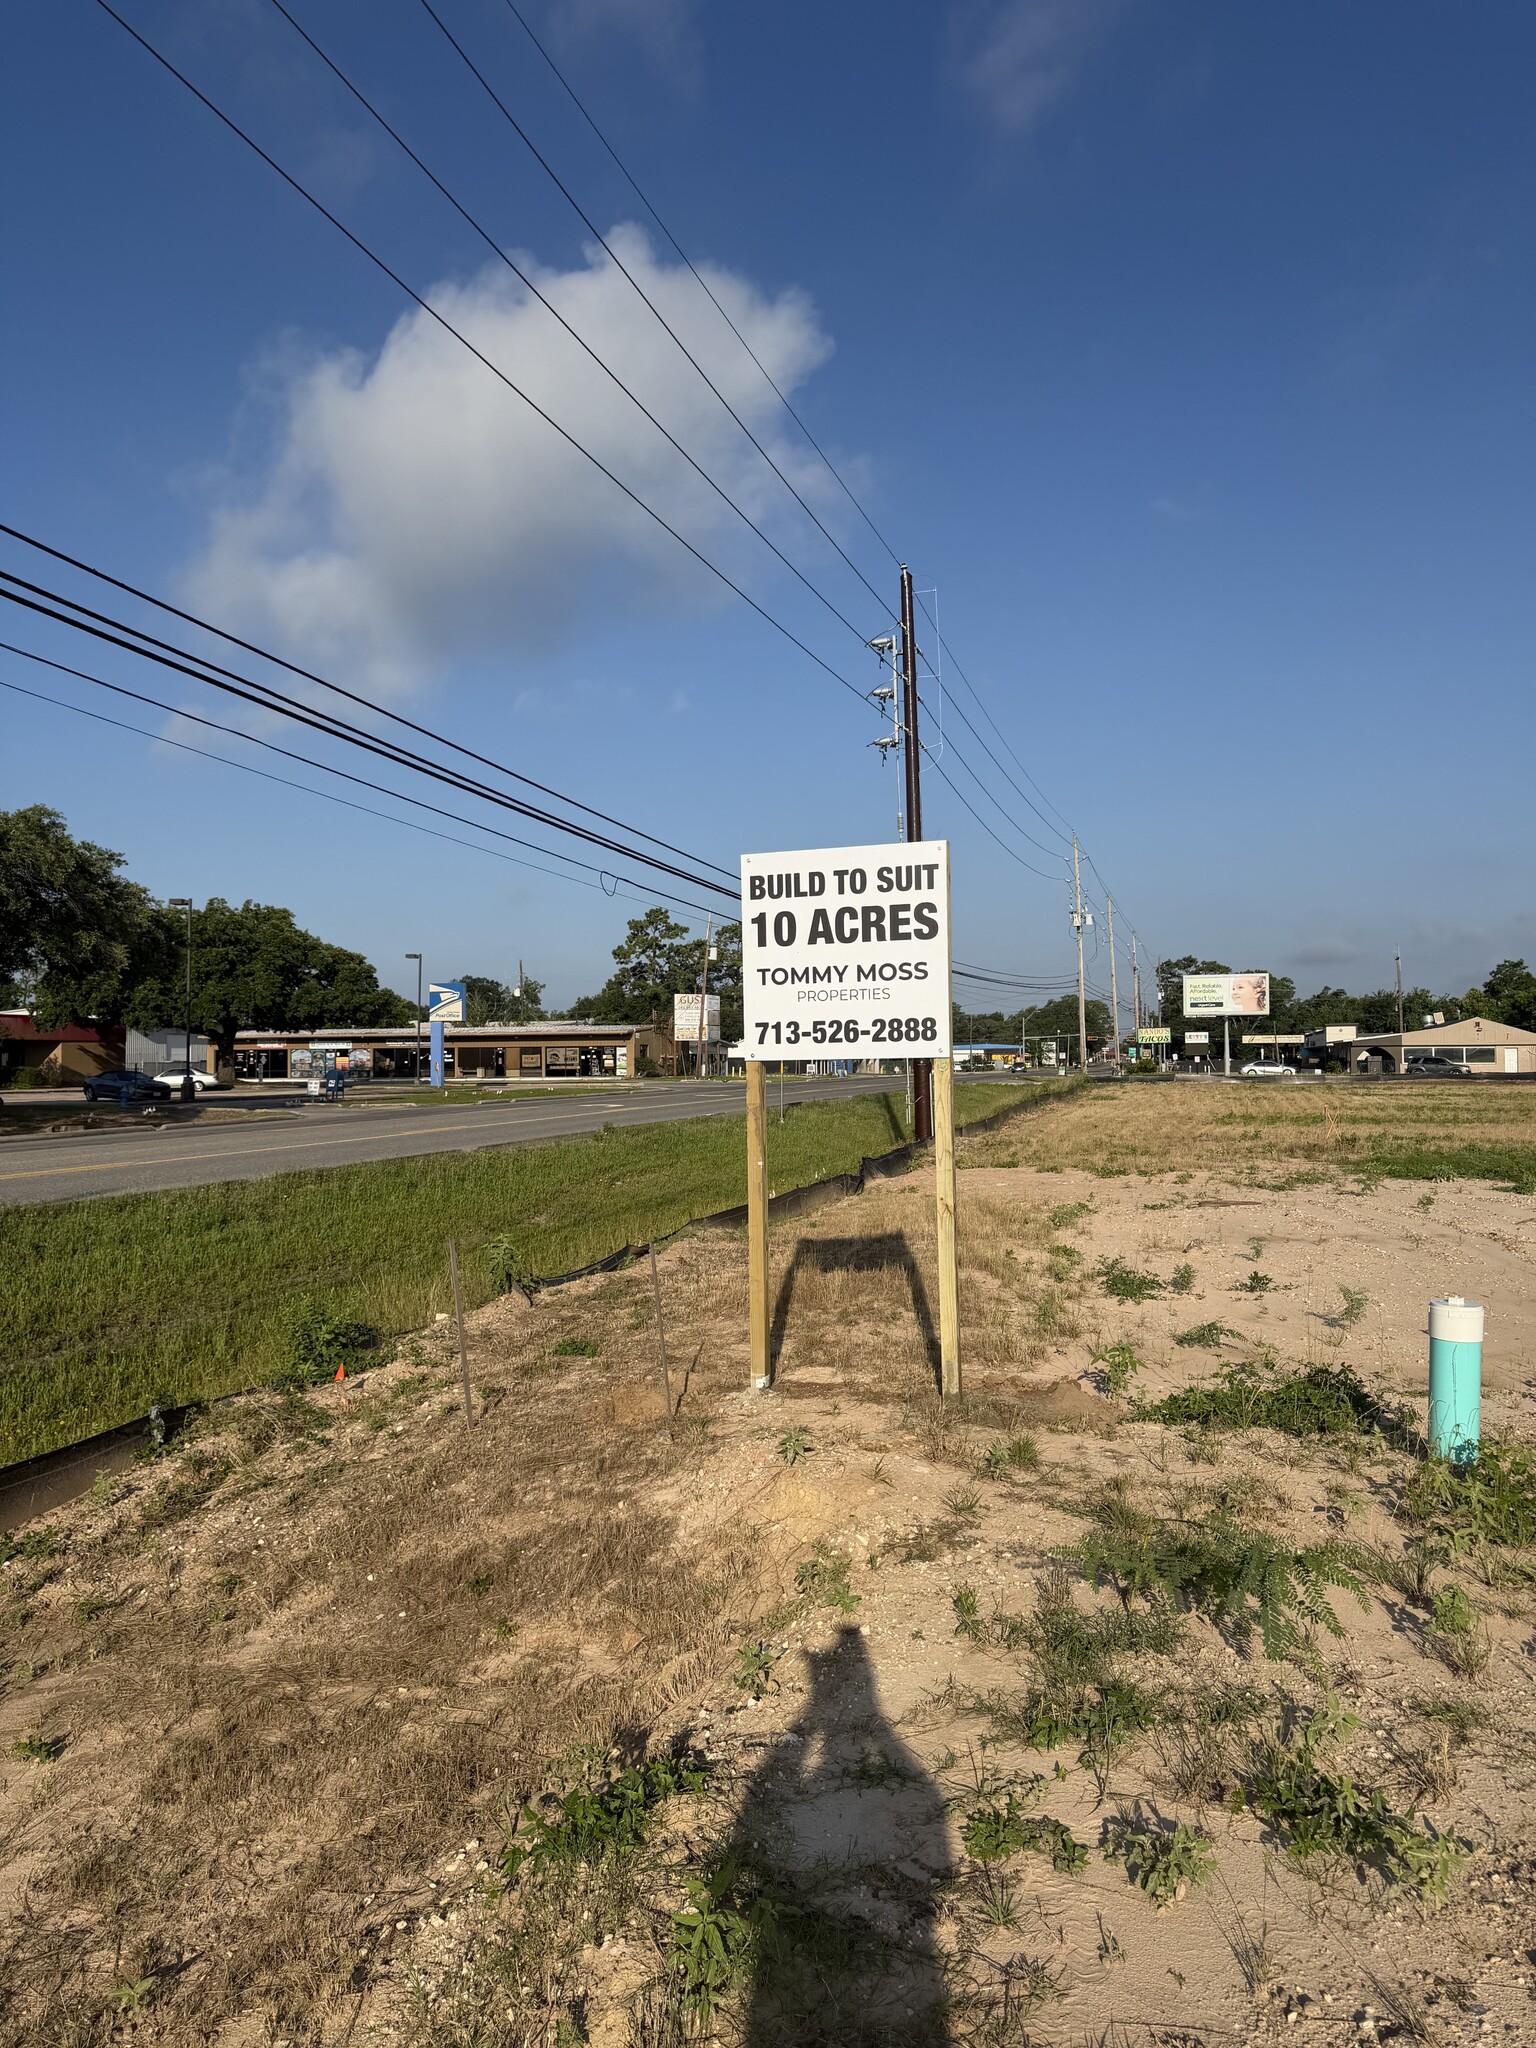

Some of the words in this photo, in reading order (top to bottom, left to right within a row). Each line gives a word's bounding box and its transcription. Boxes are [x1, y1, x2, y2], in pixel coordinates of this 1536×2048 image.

[750, 871, 825, 900] BUILD
[833, 868, 867, 895] TO
[877, 864, 939, 892] SUIT
[751, 911, 797, 947] 10
[807, 902, 939, 945] ACRES
[757, 965, 849, 986] TOMMY
[856, 962, 929, 982] MOSS
[797, 988, 891, 1002] PROPERTIES
[755, 1017, 937, 1044] 713-526-2888
[1140, 1035, 1170, 1043] TACOS
